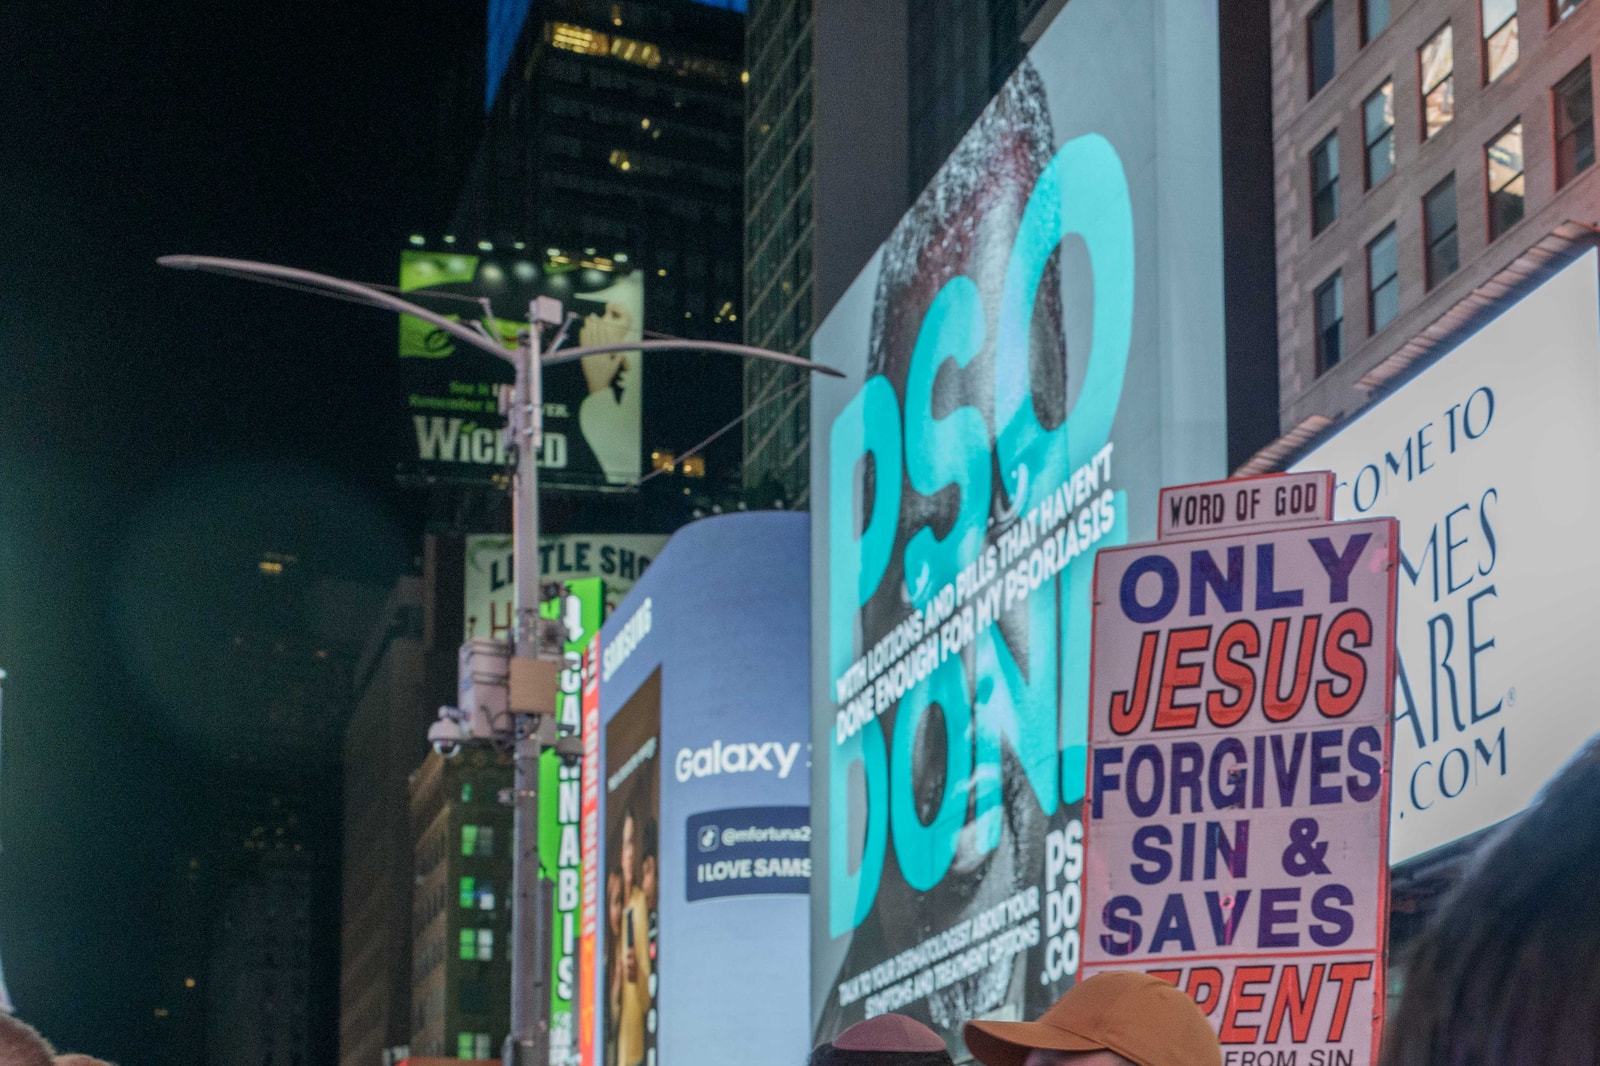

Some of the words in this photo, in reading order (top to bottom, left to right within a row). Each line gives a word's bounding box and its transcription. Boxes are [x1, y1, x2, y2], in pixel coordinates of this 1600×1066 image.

[1444, 386, 1495, 454] TO
[1171, 492, 1224, 528] WORD
[1236, 488, 1260, 521] OF
[1275, 482, 1318, 516] GOD
[489, 542, 591, 592] LITLE
[867, 608, 923, 679] LOTIONS
[923, 583, 955, 634] AND
[956, 546, 997, 604] PILLS
[997, 508, 1039, 570] THAT
[1040, 442, 1113, 535] HAVEN'T
[1119, 532, 1373, 624] ONLY
[836, 690, 875, 746] DONE
[875, 637, 939, 715] ENOUGH
[941, 606, 974, 663] FOR
[977, 578, 1005, 634] MY
[1005, 488, 1114, 610] PSORIASIS
[1108, 607, 1374, 736] JESUS
[675, 740, 800, 782] Galaxy
[1092, 725, 1383, 820] FORGIVES
[1399, 726, 1508, 818] .COM
[697, 863, 704, 883] I
[706, 859, 752, 881] LOVE
[1130, 819, 1250, 886] SIN
[1281, 817, 1333, 878] &
[1099, 883, 1355, 956] SAVES
[1146, 961, 1374, 1044] PENT
